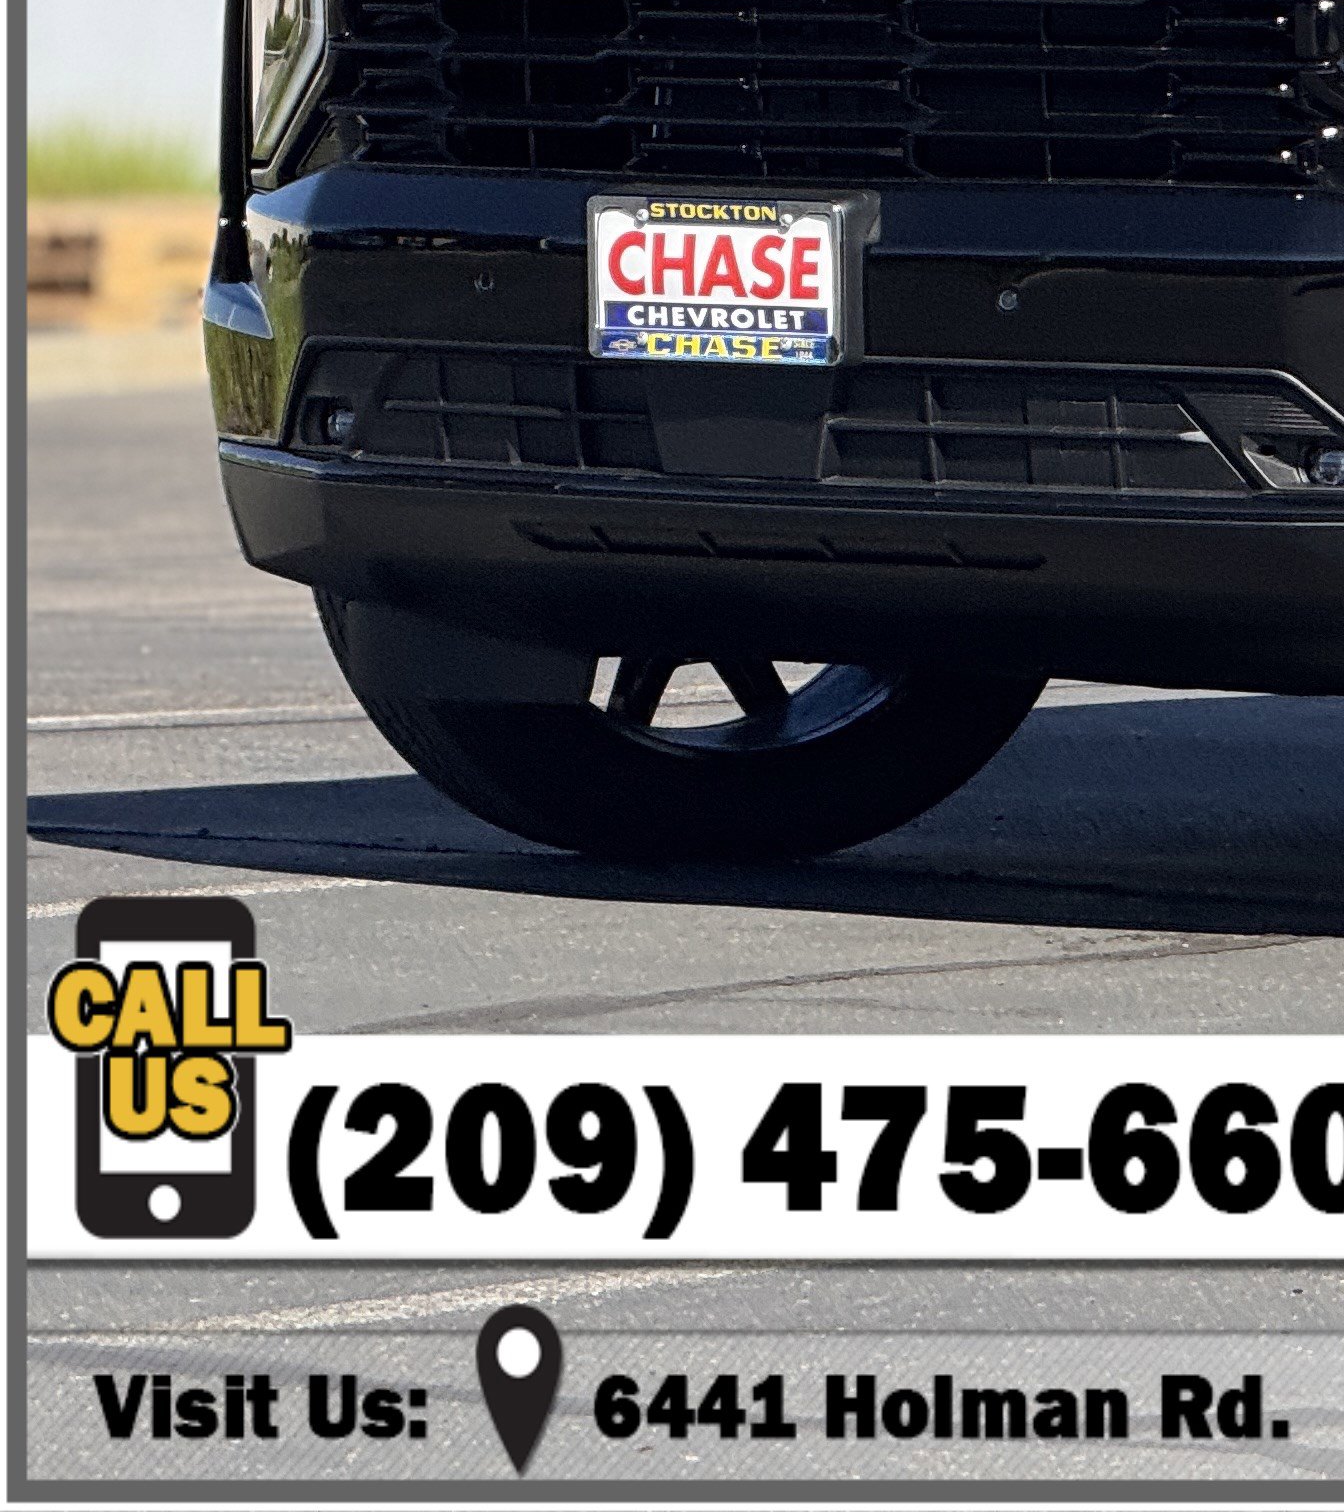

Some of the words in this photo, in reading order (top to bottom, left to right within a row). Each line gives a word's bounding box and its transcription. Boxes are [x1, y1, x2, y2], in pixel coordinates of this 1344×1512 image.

[649, 202, 777, 222] STOCKTON
[607, 231, 821, 300] CHASE
[627, 304, 805, 331] CHEVROLET
[645, 333, 783, 360] CHASE
